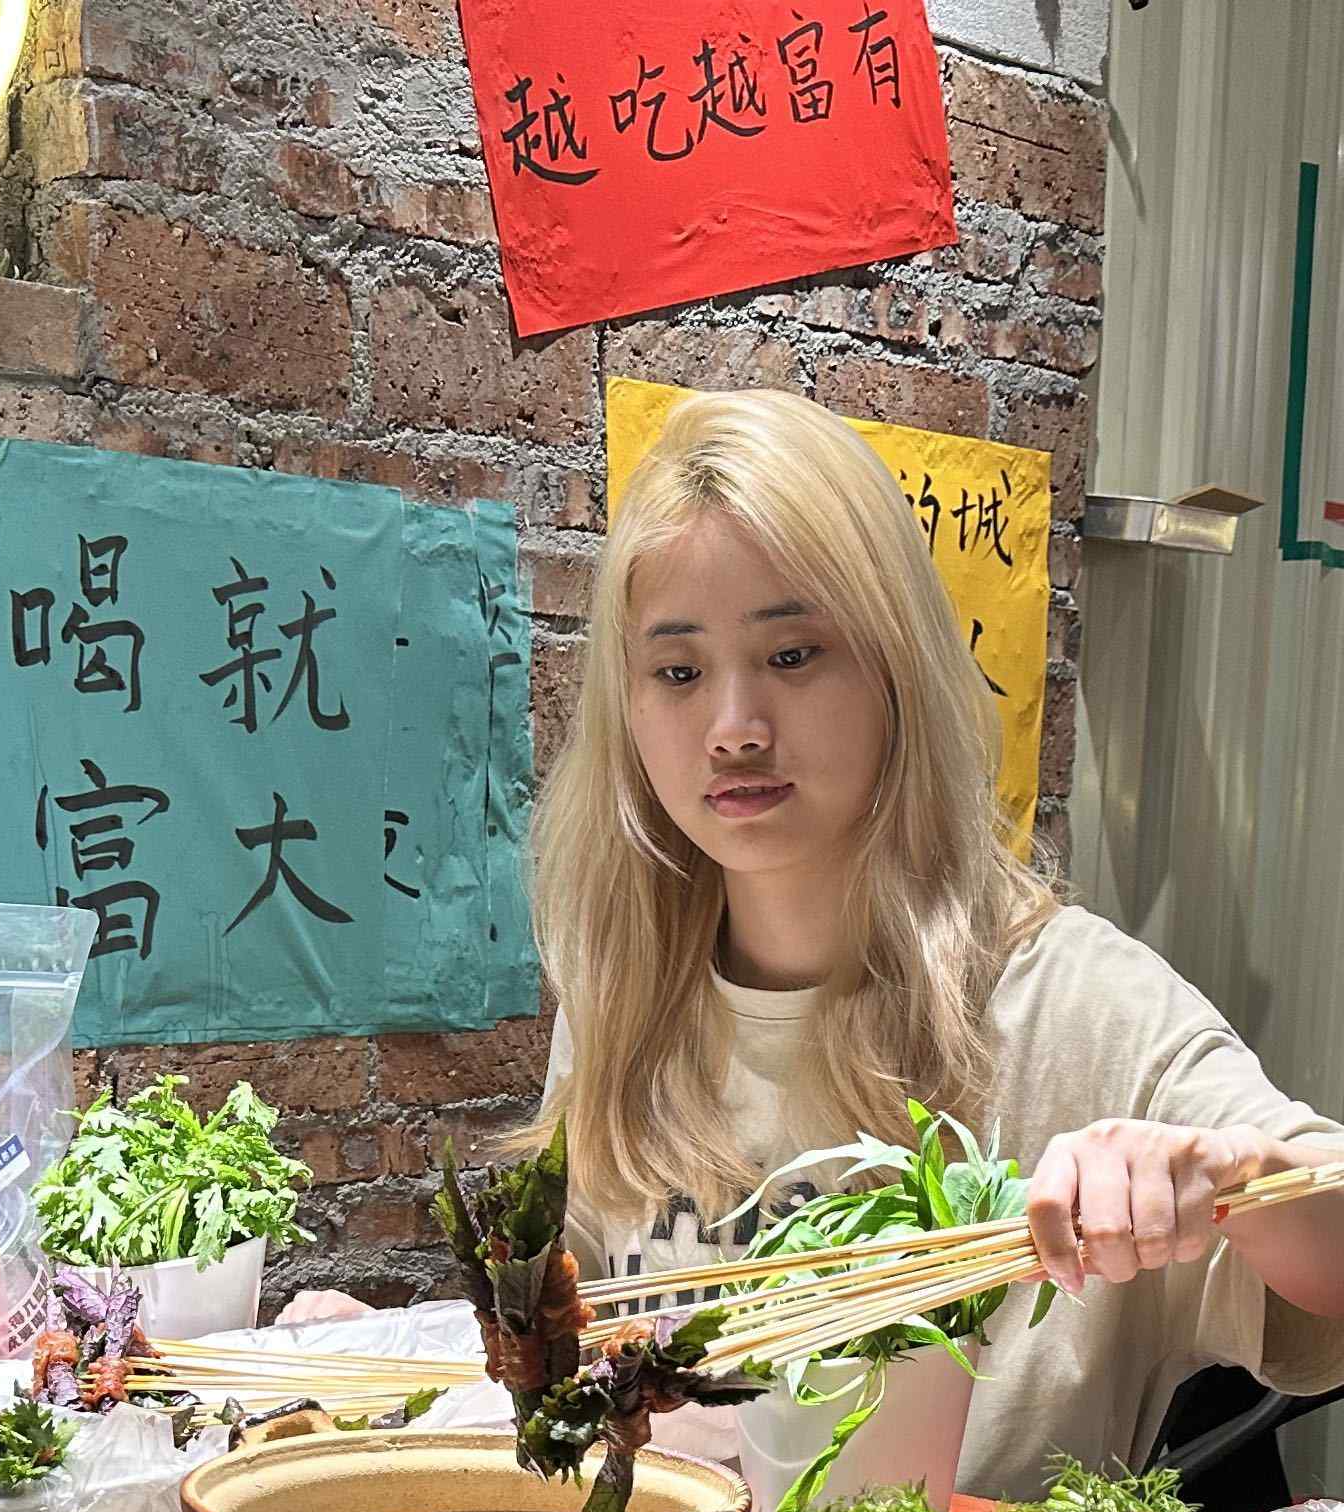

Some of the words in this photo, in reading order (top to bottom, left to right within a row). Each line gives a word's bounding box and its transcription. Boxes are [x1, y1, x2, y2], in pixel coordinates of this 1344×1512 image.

[503, 7, 904, 185] 越吃越富有
